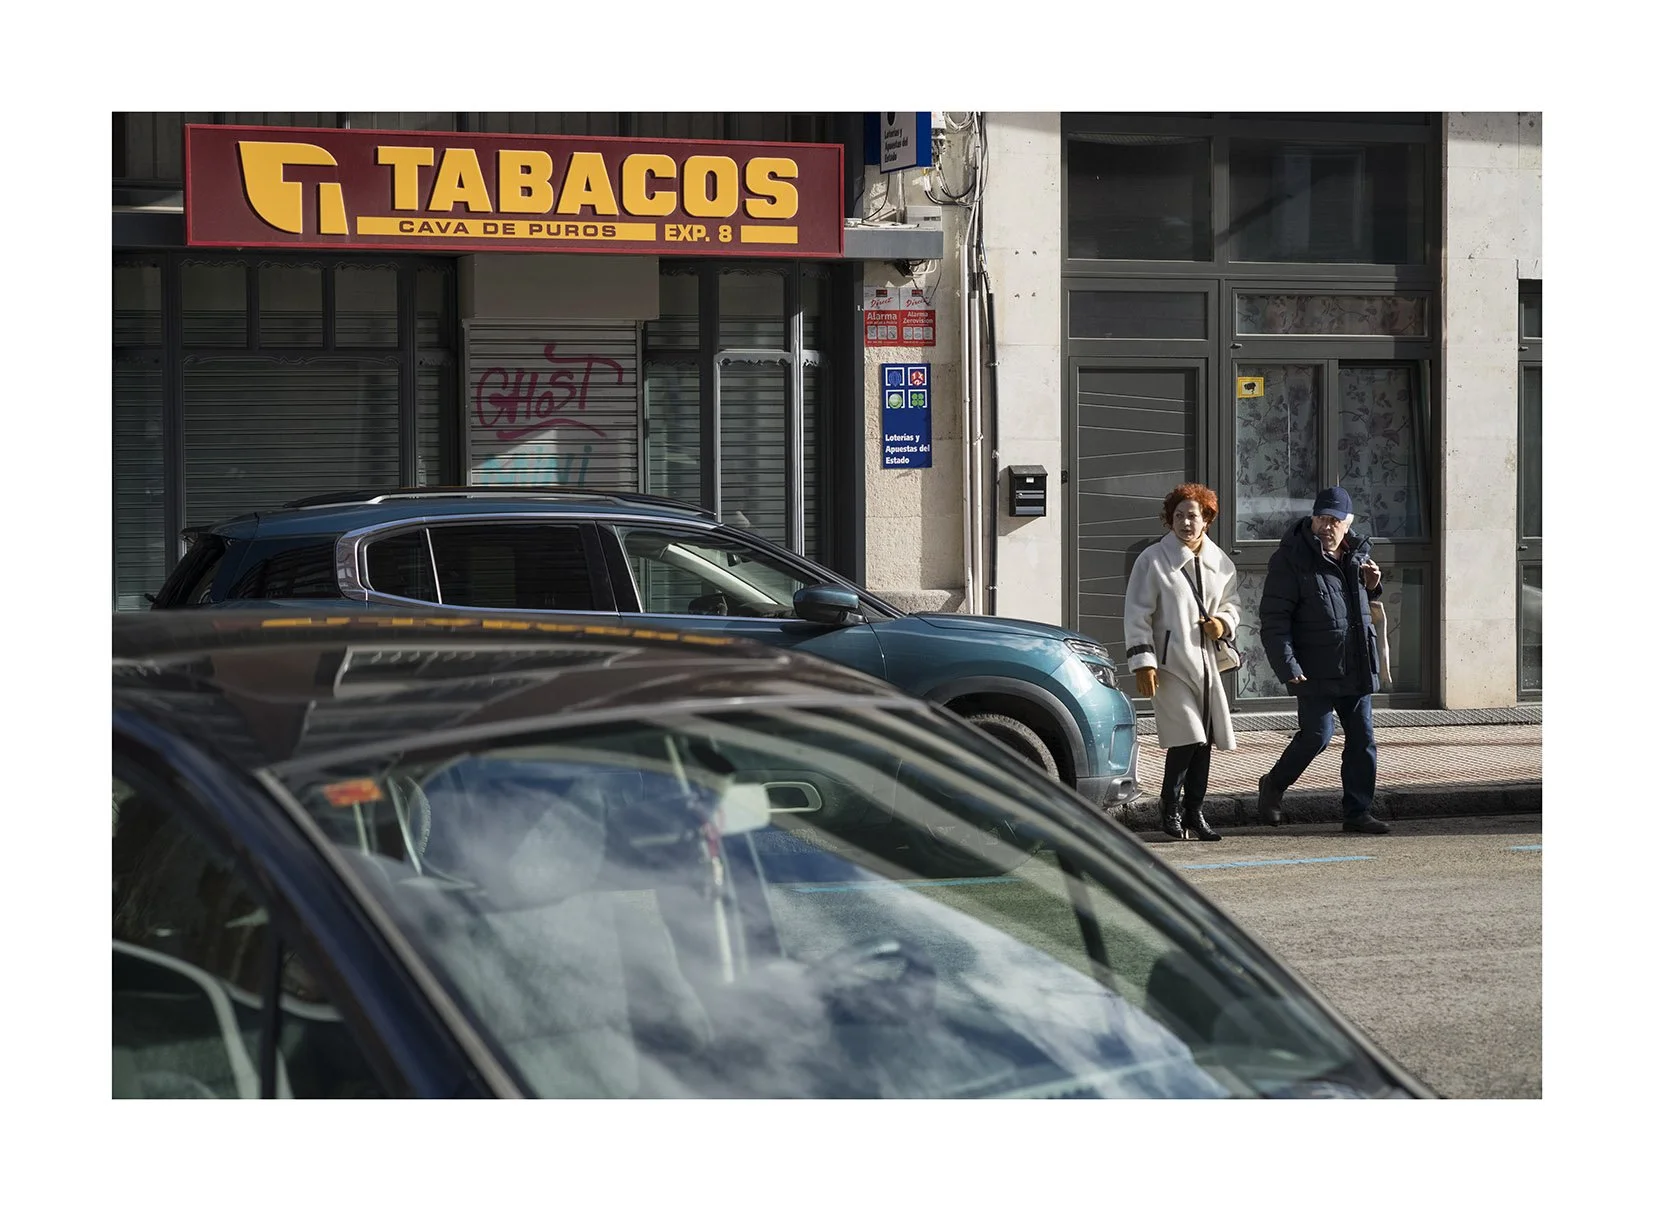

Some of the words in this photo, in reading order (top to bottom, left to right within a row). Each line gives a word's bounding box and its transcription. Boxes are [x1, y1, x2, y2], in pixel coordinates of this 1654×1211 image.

[376, 145, 799, 219] TABACOS
[399, 220, 470, 234] CAVA
[483, 222, 516, 235] DE
[529, 223, 617, 237] PUROS
[664, 223, 710, 242] EXP.
[718, 224, 733, 243] 8
[867, 311, 898, 320] Alarma
[915, 435, 920, 443] y
[885, 445, 918, 454] Apuestas
[919, 444, 930, 453] del
[885, 456, 910, 465] Estado
